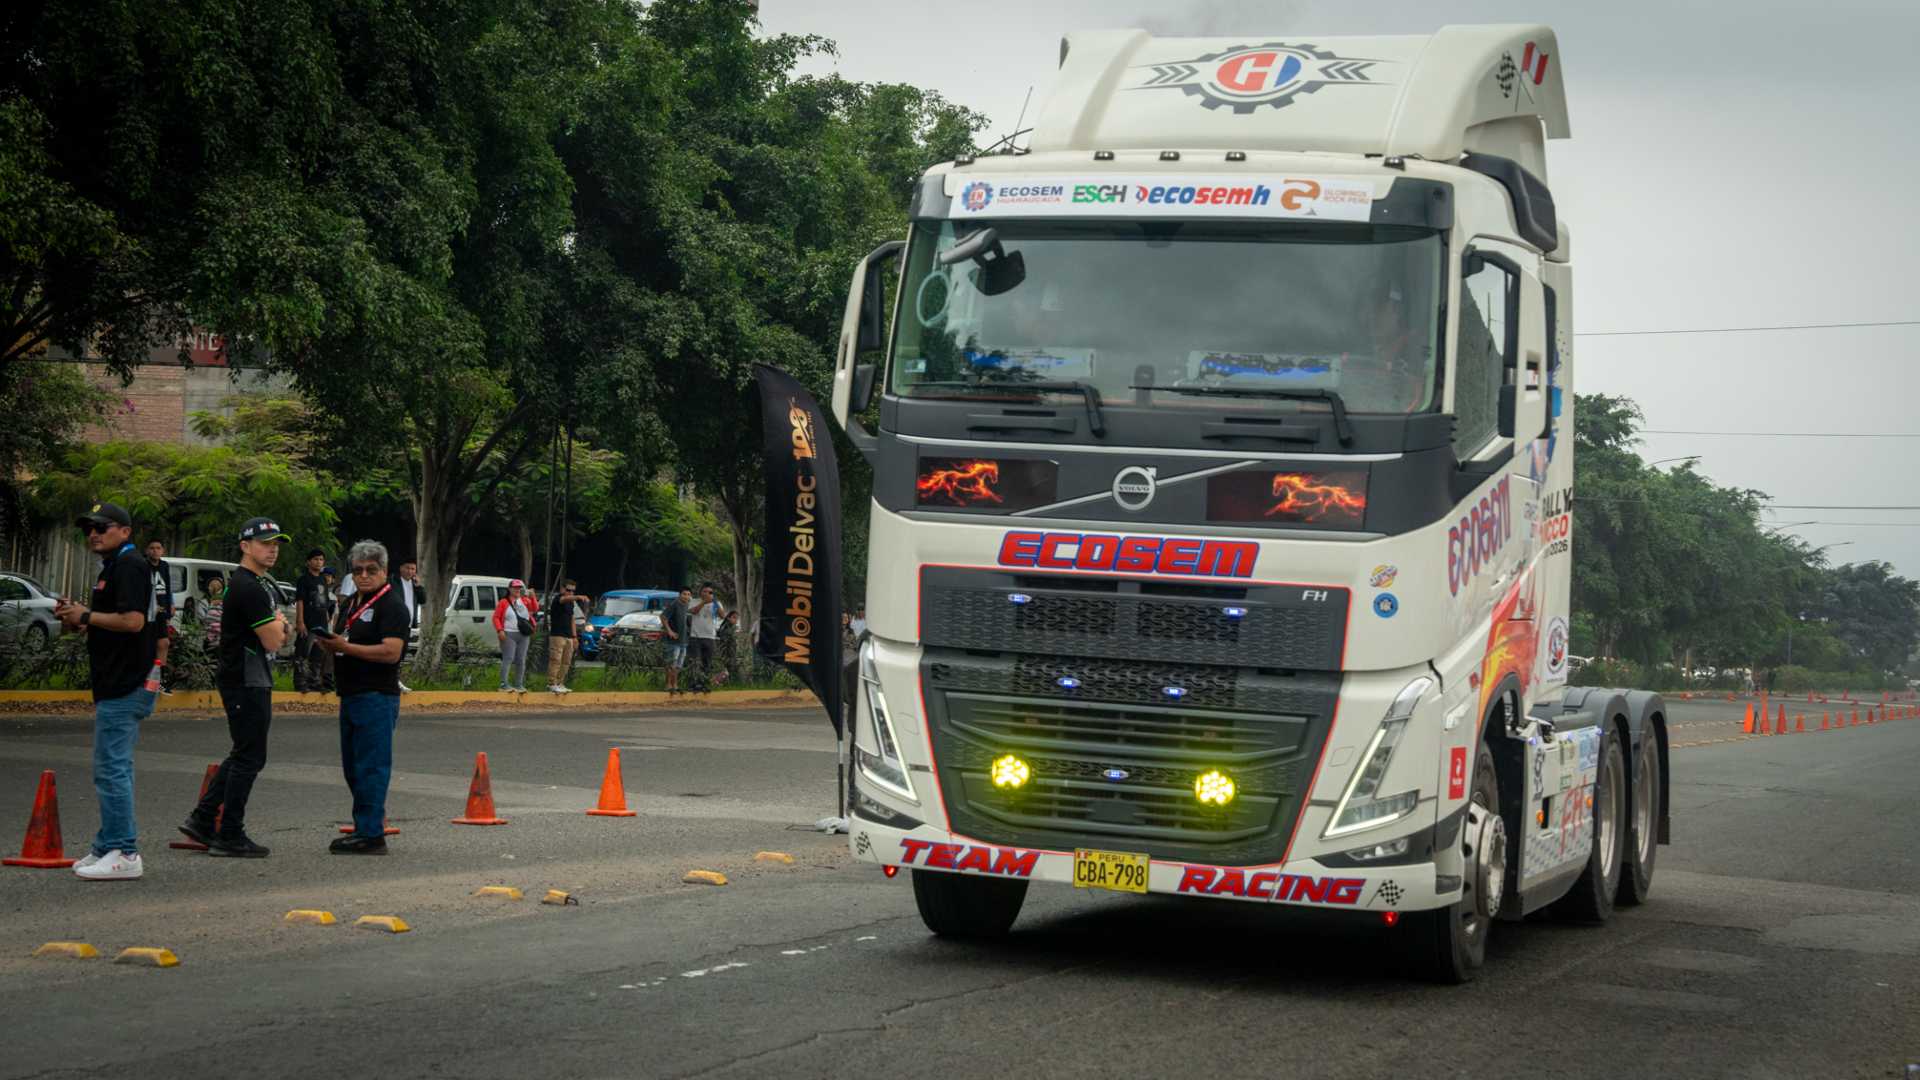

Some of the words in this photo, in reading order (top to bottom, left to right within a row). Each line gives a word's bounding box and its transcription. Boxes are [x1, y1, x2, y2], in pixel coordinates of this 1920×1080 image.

[999, 186, 1064, 197] ECOSEM
[1072, 185, 1128, 203] ESGH
[1148, 185, 1271, 205] ecosemh
[787, 474, 817, 577] Delvac
[1448, 473, 1511, 597] ECOSEM
[997, 530, 1260, 578] ECOSEM
[1302, 590, 1328, 602] FH
[784, 579, 814, 665] Mobil
[900, 838, 1040, 877] TEAM
[1077, 860, 1145, 887] CBA-798
[1098, 853, 1125, 862] PERU
[1177, 865, 1367, 905] RACING
